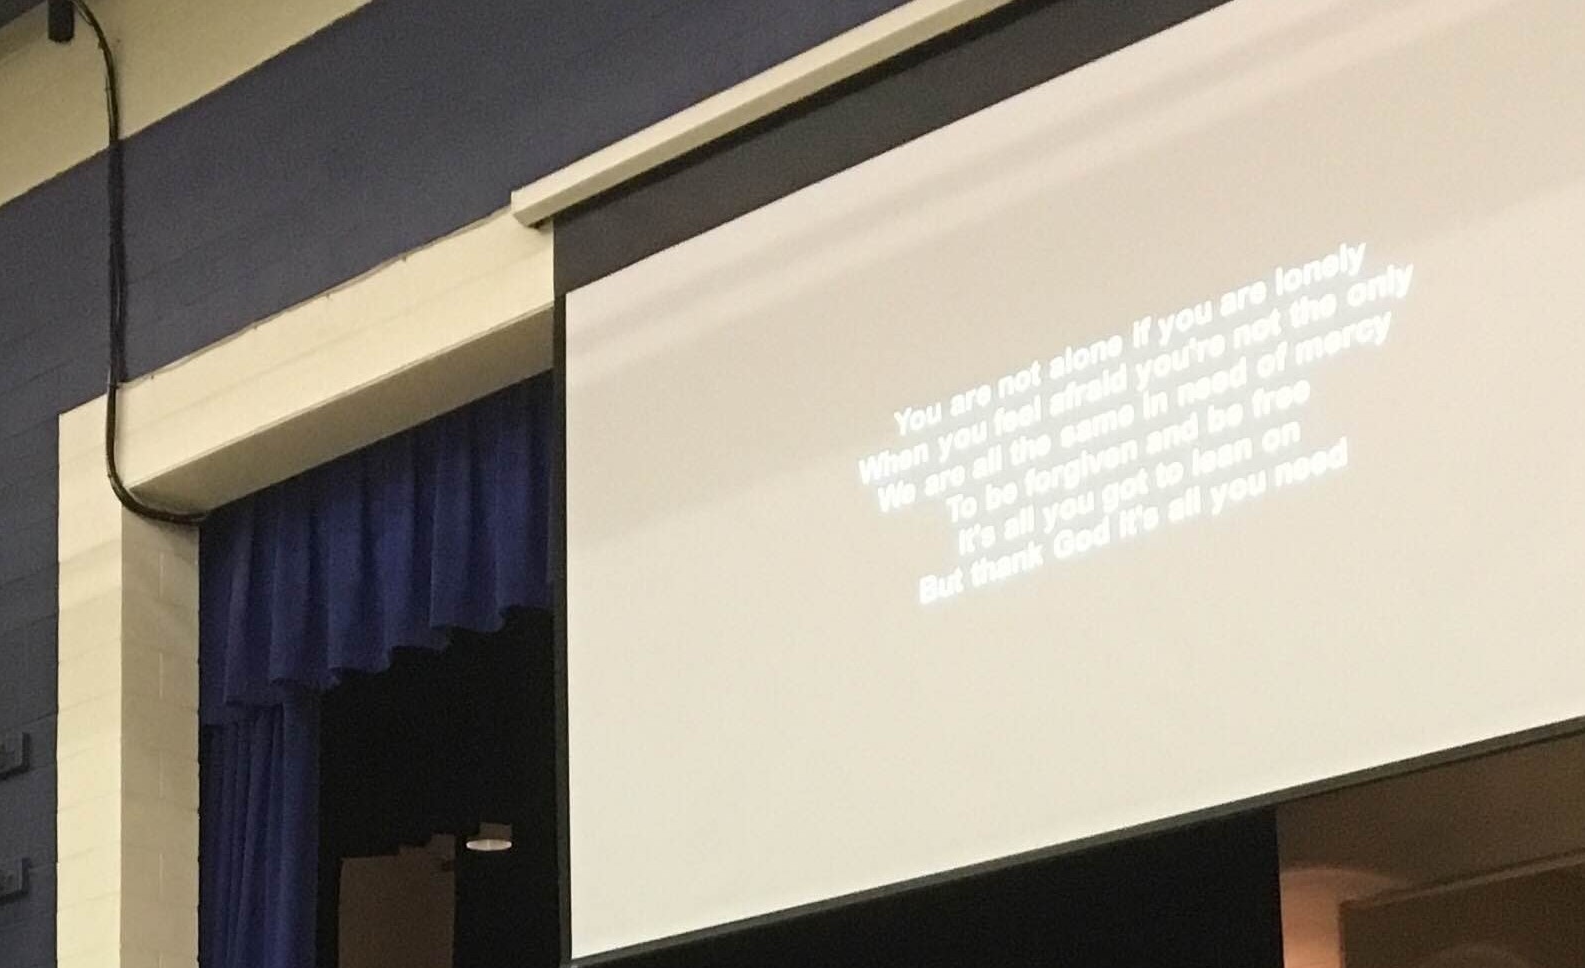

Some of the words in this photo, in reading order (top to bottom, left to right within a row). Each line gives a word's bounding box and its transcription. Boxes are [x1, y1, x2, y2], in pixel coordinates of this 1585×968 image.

[858, 443, 929, 485] When
[938, 421, 987, 463] you
[994, 394, 1041, 437] feel
[1049, 363, 1127, 417] afraid
[1136, 334, 1226, 392] you're
[1234, 308, 1281, 349] not
[1290, 293, 1337, 328] the
[1347, 264, 1414, 307] only
[878, 480, 916, 513] We
[924, 464, 965, 497] are
[972, 443, 1003, 479] all
[1010, 434, 1052, 466] the
[1061, 404, 1134, 449] same
[1143, 390, 1168, 420] in
[1177, 356, 1247, 406] need
[1257, 341, 1288, 379] of
[1295, 310, 1391, 366] mercy
[894, 402, 942, 436] You
[950, 384, 991, 416] are
[998, 360, 1042, 399] not
[1049, 335, 1123, 379] alone
[1158, 300, 1212, 347] you
[1220, 281, 1266, 317] are
[1276, 242, 1366, 296] lonely
[919, 566, 964, 605] But
[970, 540, 1043, 588] thank
[1053, 515, 1110, 559] God
[1168, 485, 1201, 521] all
[1210, 469, 1266, 516] you
[1275, 436, 1348, 487] need
[945, 493, 977, 523] To
[985, 482, 1018, 511] be
[1025, 439, 1138, 497] forgiven
[1146, 411, 1198, 455] and
[1207, 403, 1244, 434] be
[1252, 379, 1310, 419] free
[959, 523, 995, 556] It's
[1004, 504, 1034, 541] all
[1042, 490, 1094, 534] you
[1102, 468, 1149, 514] got
[1155, 461, 1184, 488] to
[1192, 437, 1253, 476] lean
[1261, 421, 1301, 453] on
